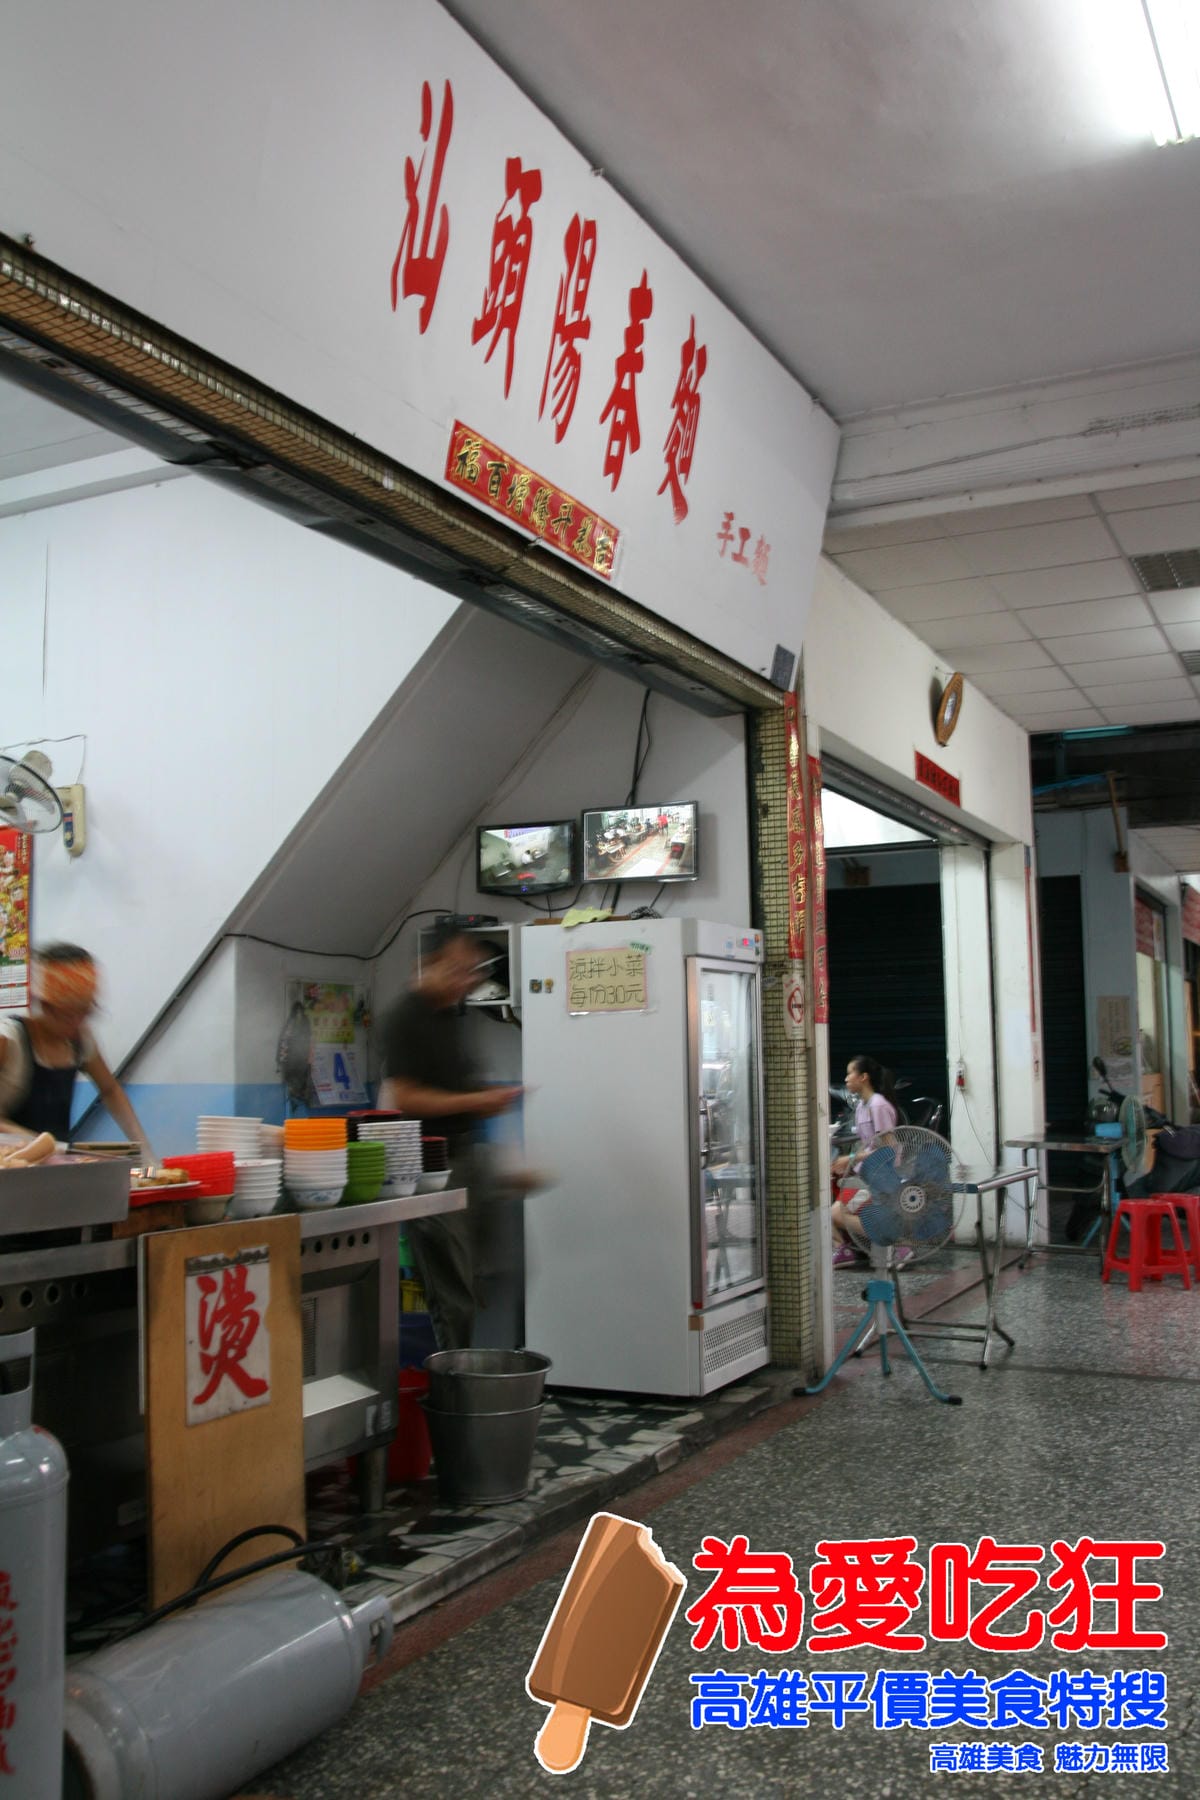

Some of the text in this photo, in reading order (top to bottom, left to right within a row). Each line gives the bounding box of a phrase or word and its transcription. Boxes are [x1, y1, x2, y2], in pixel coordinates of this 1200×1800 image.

[390, 79, 708, 524] 汕頭陽春麵
[717, 511, 771, 586] 手工麵
[569, 954, 644, 980] 涼拌小菜
[569, 983, 645, 1008] 每份30元
[333, 1052, 351, 1090] 4
